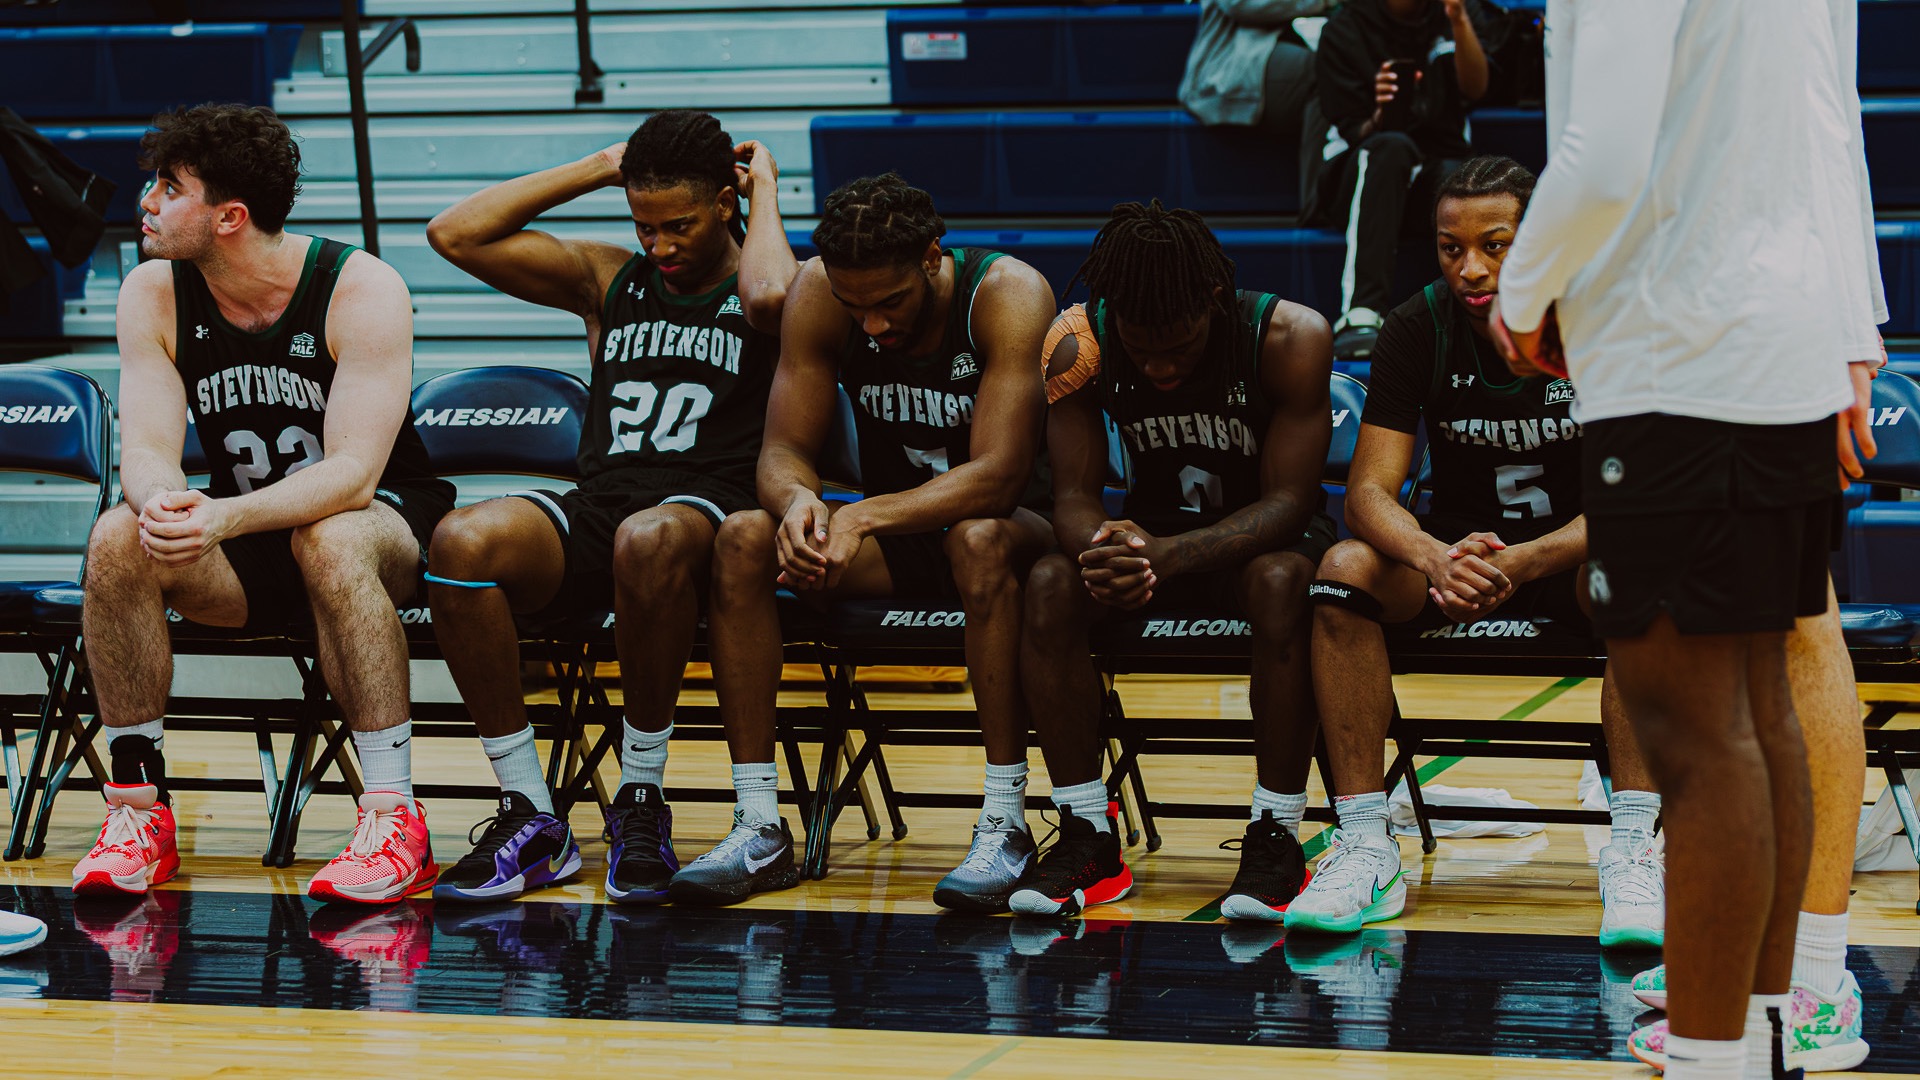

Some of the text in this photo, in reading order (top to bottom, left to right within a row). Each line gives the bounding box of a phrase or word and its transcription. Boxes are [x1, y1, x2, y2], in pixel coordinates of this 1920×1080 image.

[291, 343, 314, 355] MAC
[604, 320, 743, 375] STEVENSON
[952, 363, 978, 377] MAC
[197, 364, 327, 415] STEVENSON
[859, 383, 977, 428] STEVENSO
[1549, 390, 1575, 402] MAC
[414, 407, 569, 427] MESSIAH
[608, 380, 714, 455] 20
[223, 425, 324, 496] 22
[1495, 464, 1553, 519] 5
[1313, 584, 1348, 598] McDavid
[880, 610, 966, 627] FALCO
